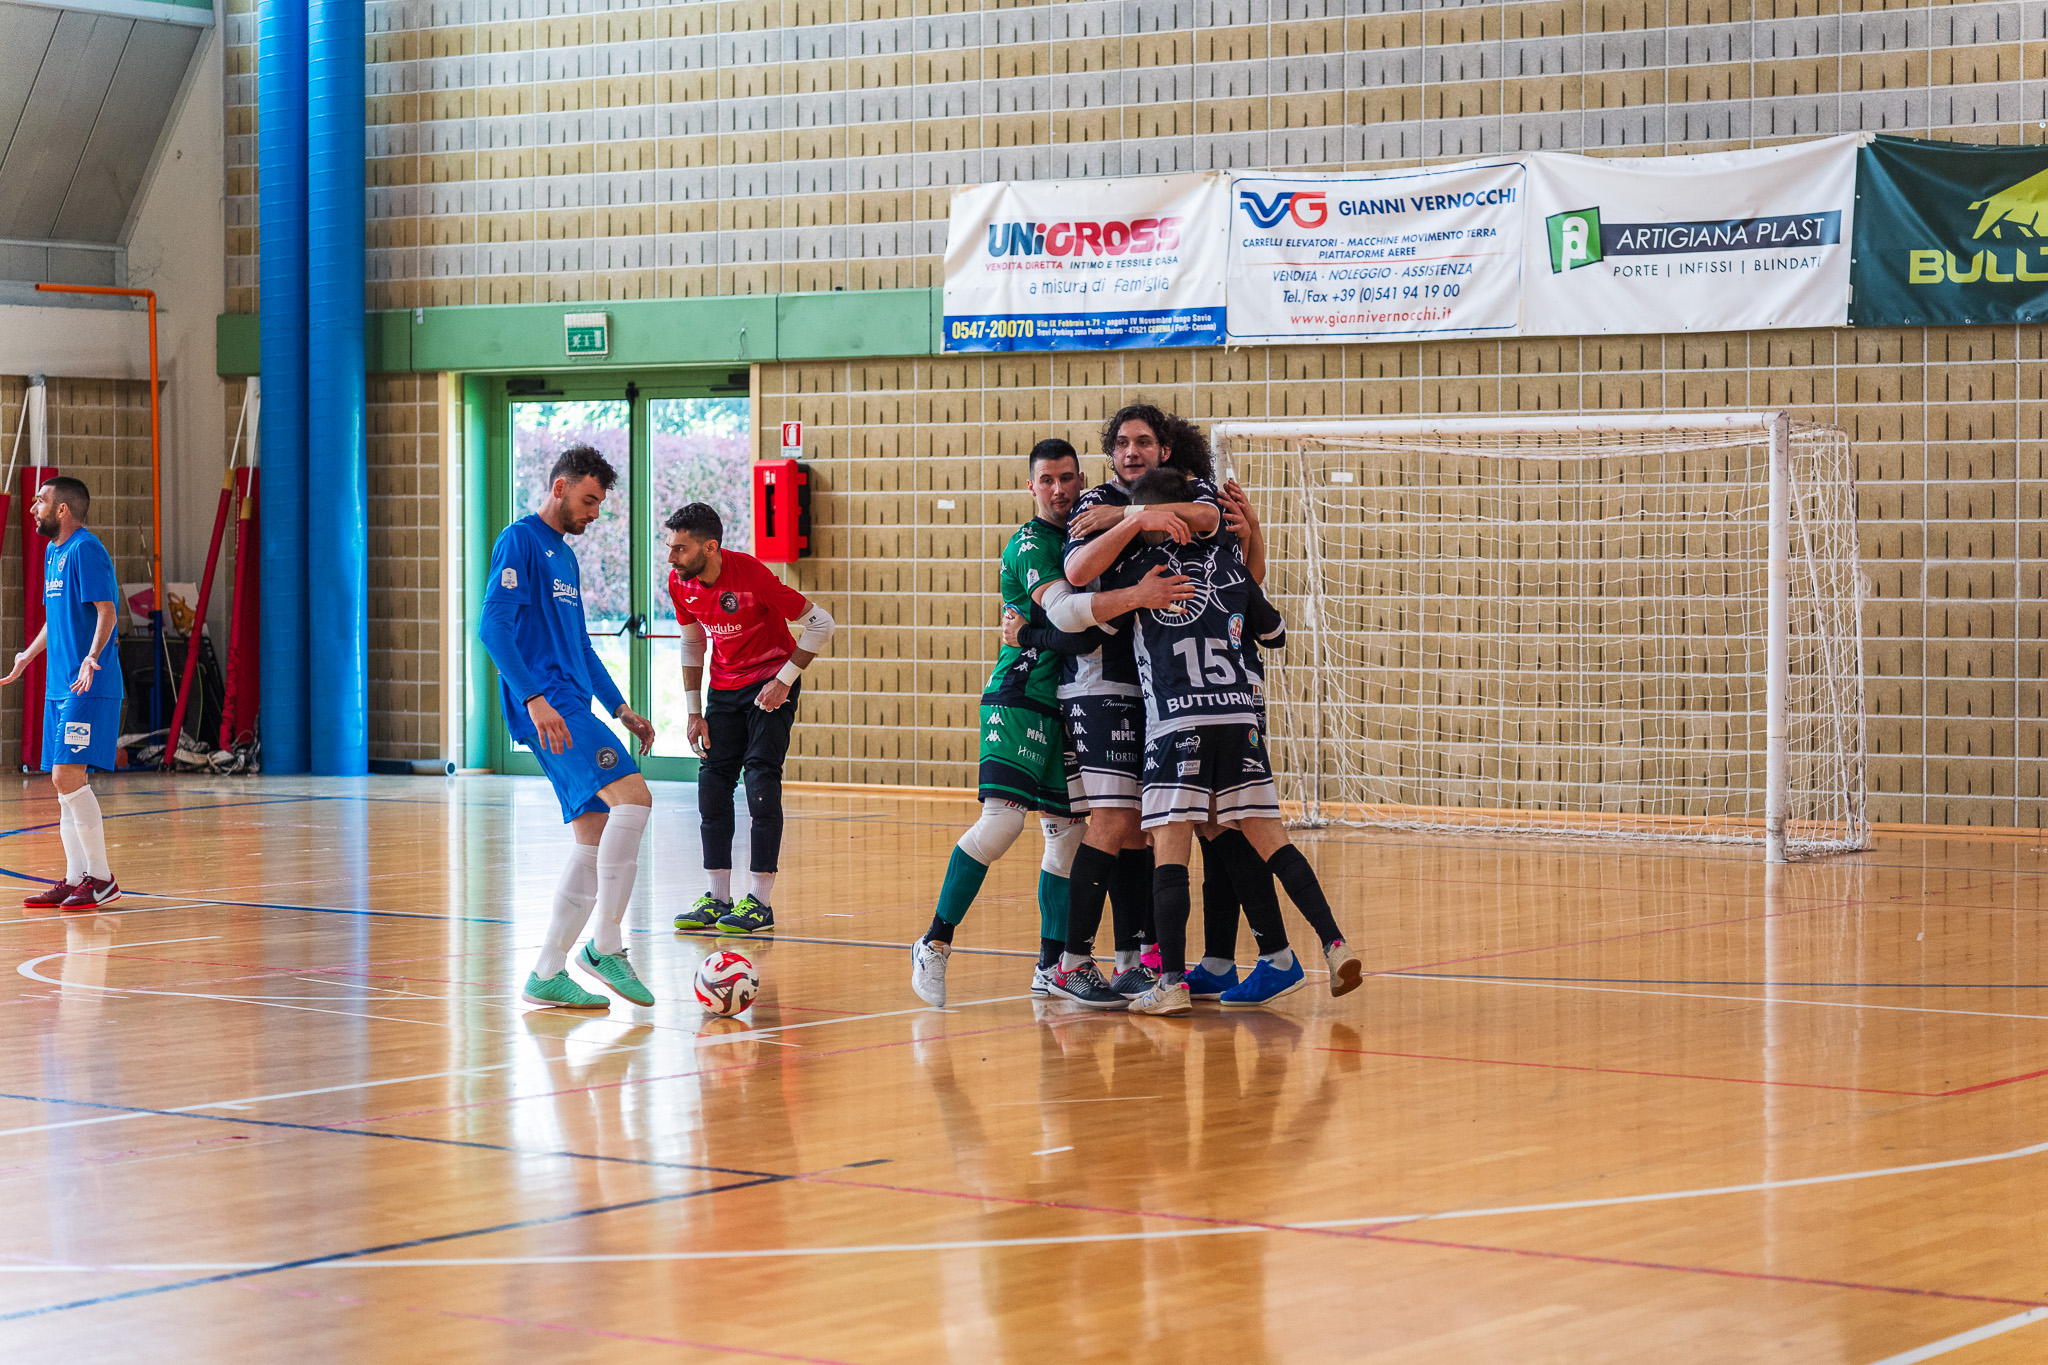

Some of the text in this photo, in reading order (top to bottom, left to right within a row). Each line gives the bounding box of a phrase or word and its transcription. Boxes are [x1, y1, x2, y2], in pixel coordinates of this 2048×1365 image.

[1338, 188, 1517, 216] GIANNI VERNOCCHI
[1242, 237, 1283, 248] CARRELLI
[1285, 238, 1338, 248] ELEVATORI
[1347, 235, 1399, 247] MACCHINE
[1400, 230, 1464, 244] MOVIMENTO
[1466, 228, 1497, 238] TERRA
[1616, 218, 1825, 250] ARTIGIANA PLAST
[1318, 246, 1416, 259] PIATTAFORME AEREE
[985, 256, 1178, 272] VENDITA DIRETTA INTIMO E TESSILE CASA
[1273, 270, 1318, 282] VENDITA
[1328, 267, 1392, 281] NOLEGGIO
[1402, 263, 1473, 277] ASSISTENZA
[1613, 264, 1658, 277] PORTE
[1679, 261, 1732, 275] INFISSI
[1754, 256, 1821, 272] BLINDATI
[1909, 247, 2048, 284] BULL
[1029, 282, 1037, 295] a
[1041, 278, 1087, 295] misura
[1092, 277, 1106, 292] di
[1332, 288, 1356, 302] +39
[1402, 285, 1418, 299] 94
[1425, 284, 1440, 298] 19
[1443, 283, 1460, 297] 00
[1291, 305, 1452, 328] www.giannivernocchi.it
[952, 319, 1034, 339] 0547-20070
[1172, 637, 1237, 688] 15
